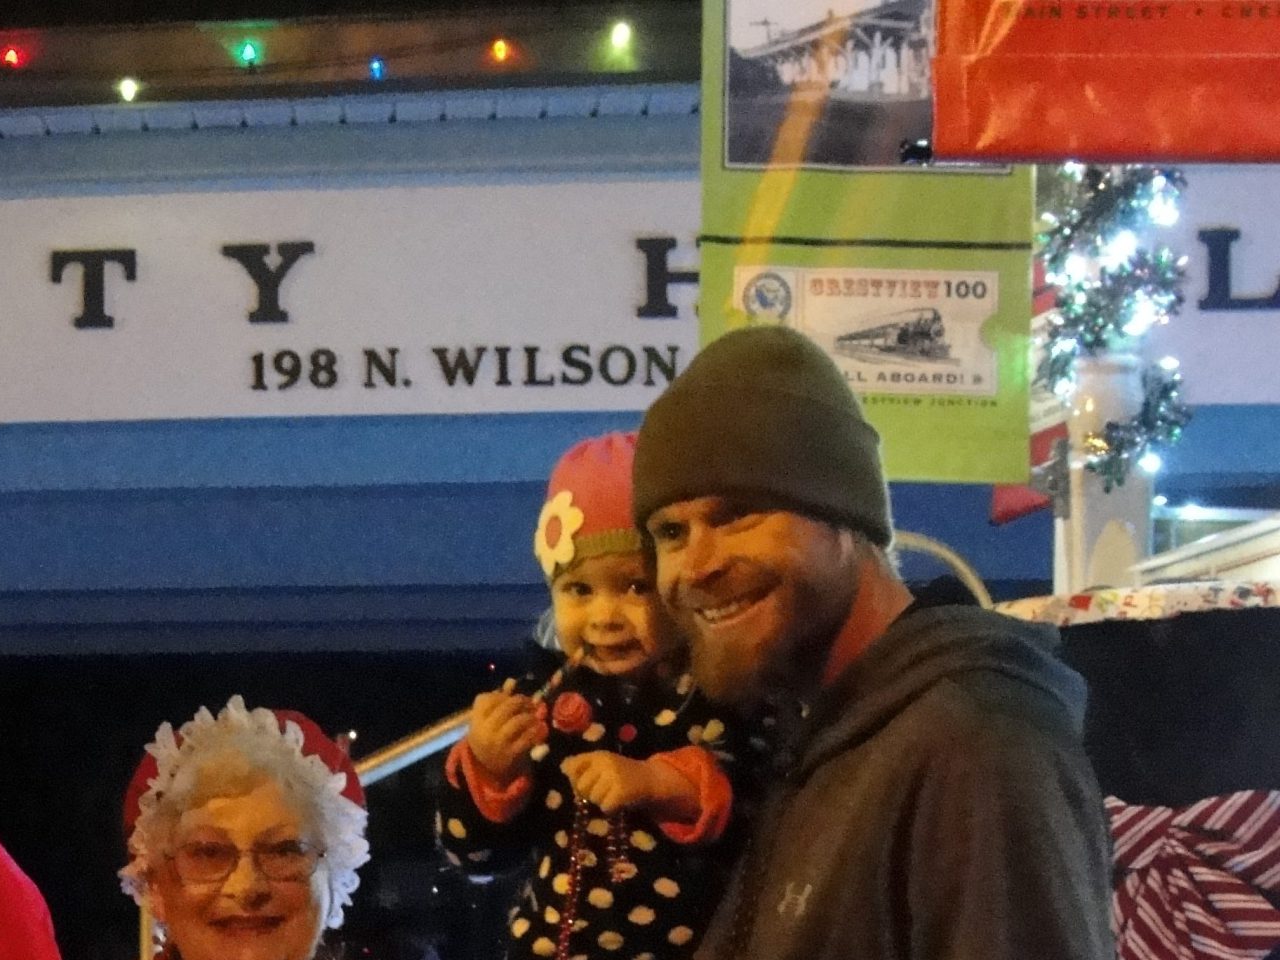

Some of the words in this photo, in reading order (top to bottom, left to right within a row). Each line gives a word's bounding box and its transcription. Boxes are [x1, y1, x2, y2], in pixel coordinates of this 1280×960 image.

[1221, 4, 1280, 19] CRE
[810, 278, 939, 299] CRESTVIEW
[943, 279, 988, 300] 100
[250, 349, 338, 391] 198
[362, 348, 412, 389] N.
[431, 343, 680, 388] WILSON
[843, 371, 867, 382] LL
[876, 372, 965, 385] ABOARD!
